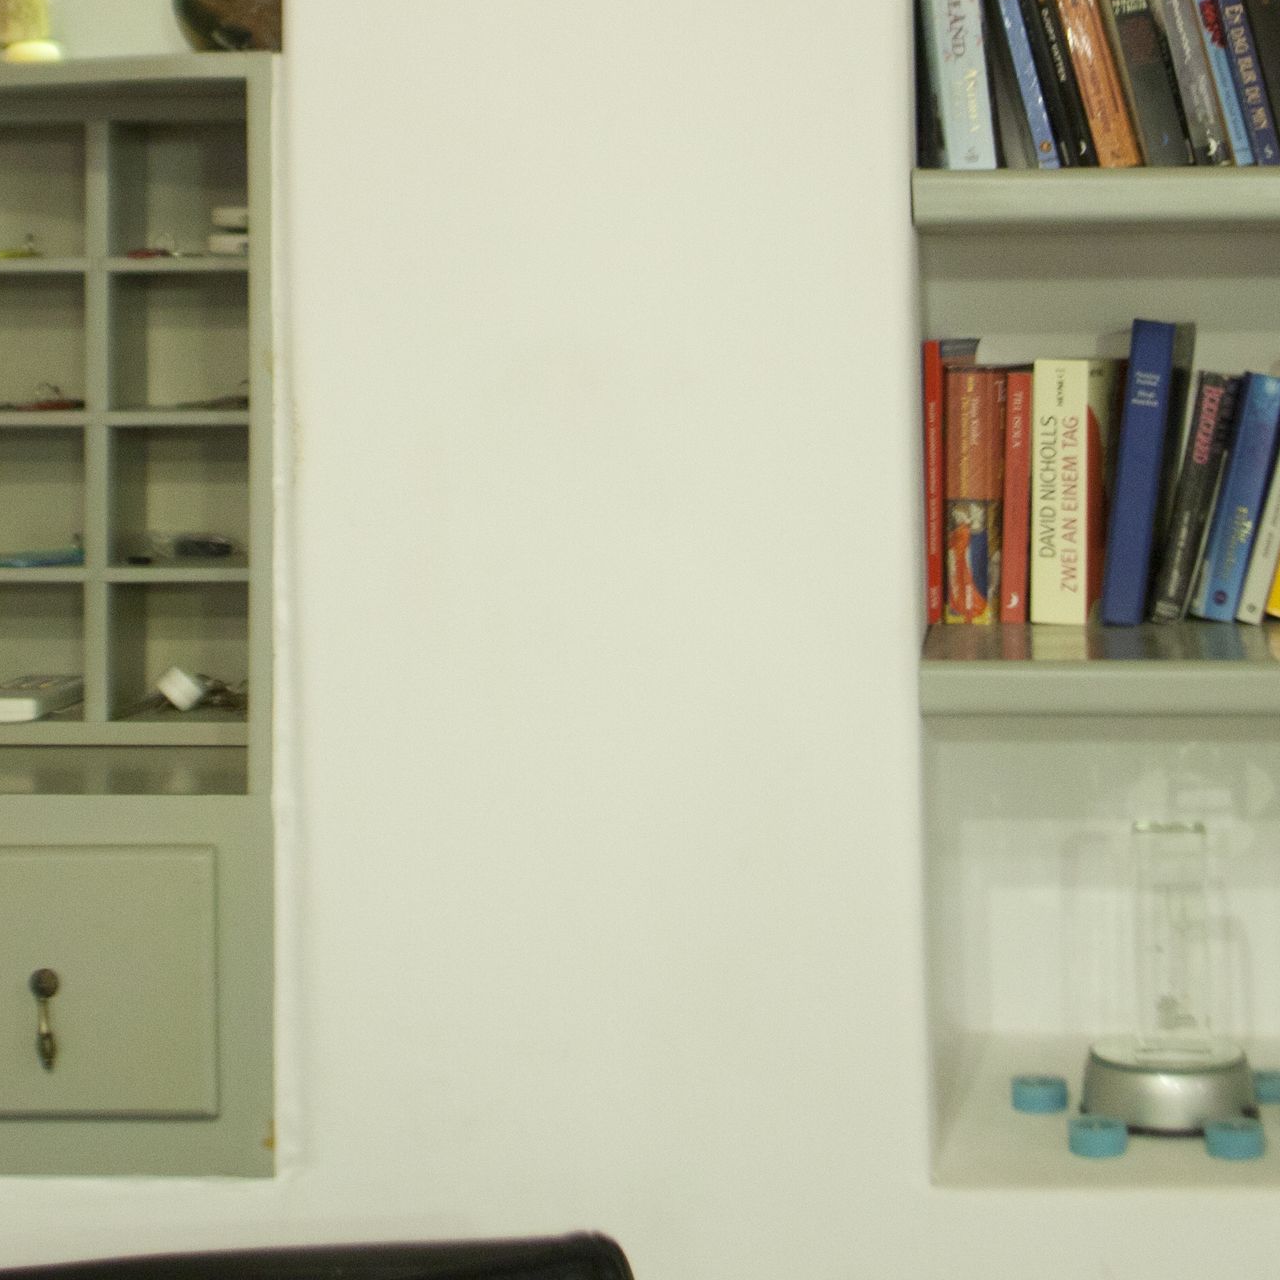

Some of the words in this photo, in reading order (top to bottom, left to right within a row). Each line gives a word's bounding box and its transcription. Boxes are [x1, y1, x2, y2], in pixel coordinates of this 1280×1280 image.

[1229, 25, 1250, 55] DAG
[1243, 84, 1263, 106] DU
[1038, 415, 1057, 500] NICHOLLS
[1061, 415, 1079, 449] TAG
[1061, 455, 1079, 512] EINEM
[1038, 505, 1057, 558] DAVID
[1061, 516, 1079, 543] AN
[1059, 547, 1080, 593] ZWEI
